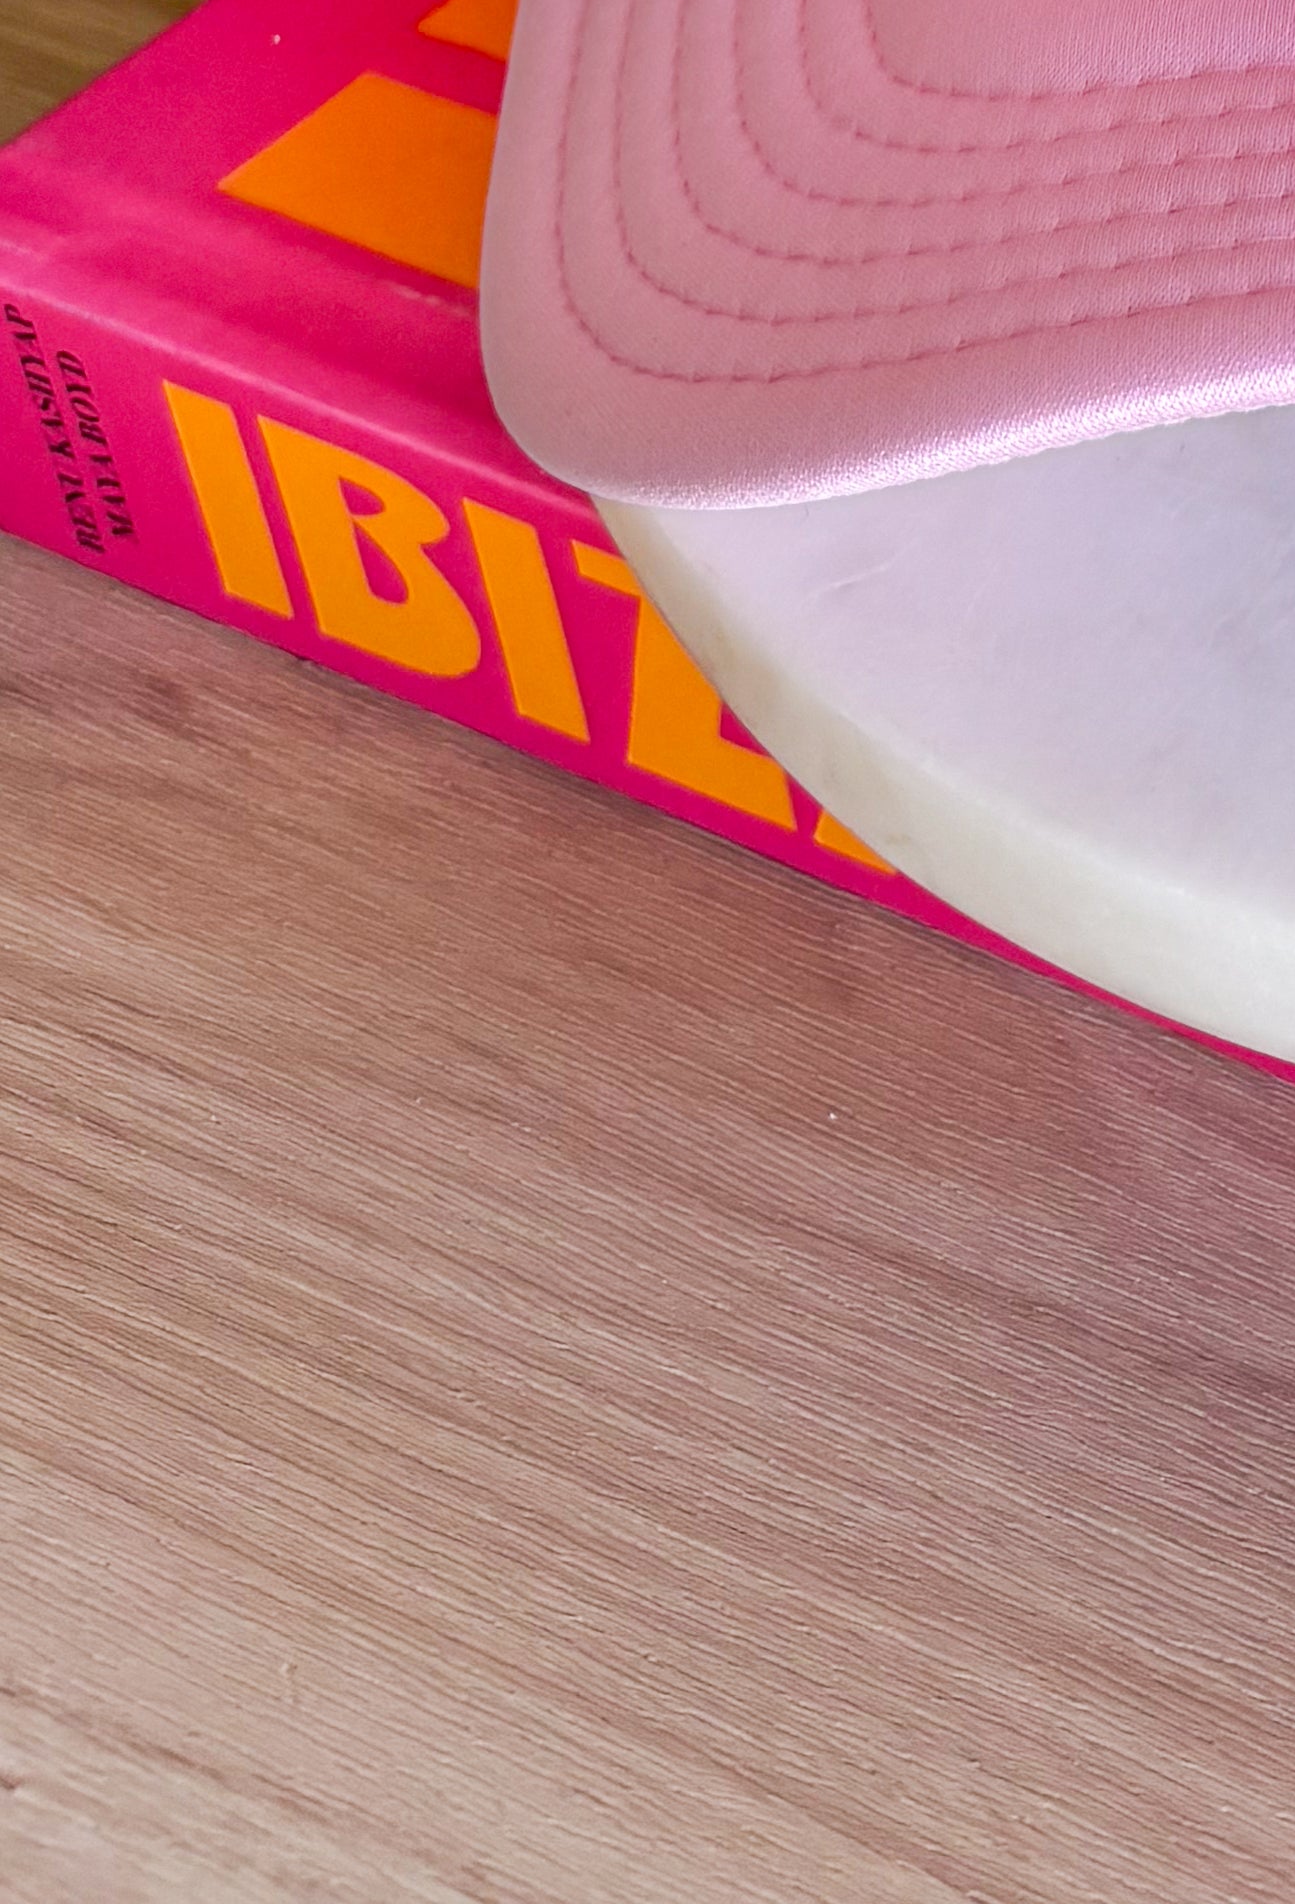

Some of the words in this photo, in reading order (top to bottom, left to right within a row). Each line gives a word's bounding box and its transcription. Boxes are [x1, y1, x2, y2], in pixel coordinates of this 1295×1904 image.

[3, 303, 76, 459] KASHYAP
[56, 349, 109, 448] BOYD
[89, 454, 140, 544] MAYA
[162, 378, 897, 876] IBIZ
